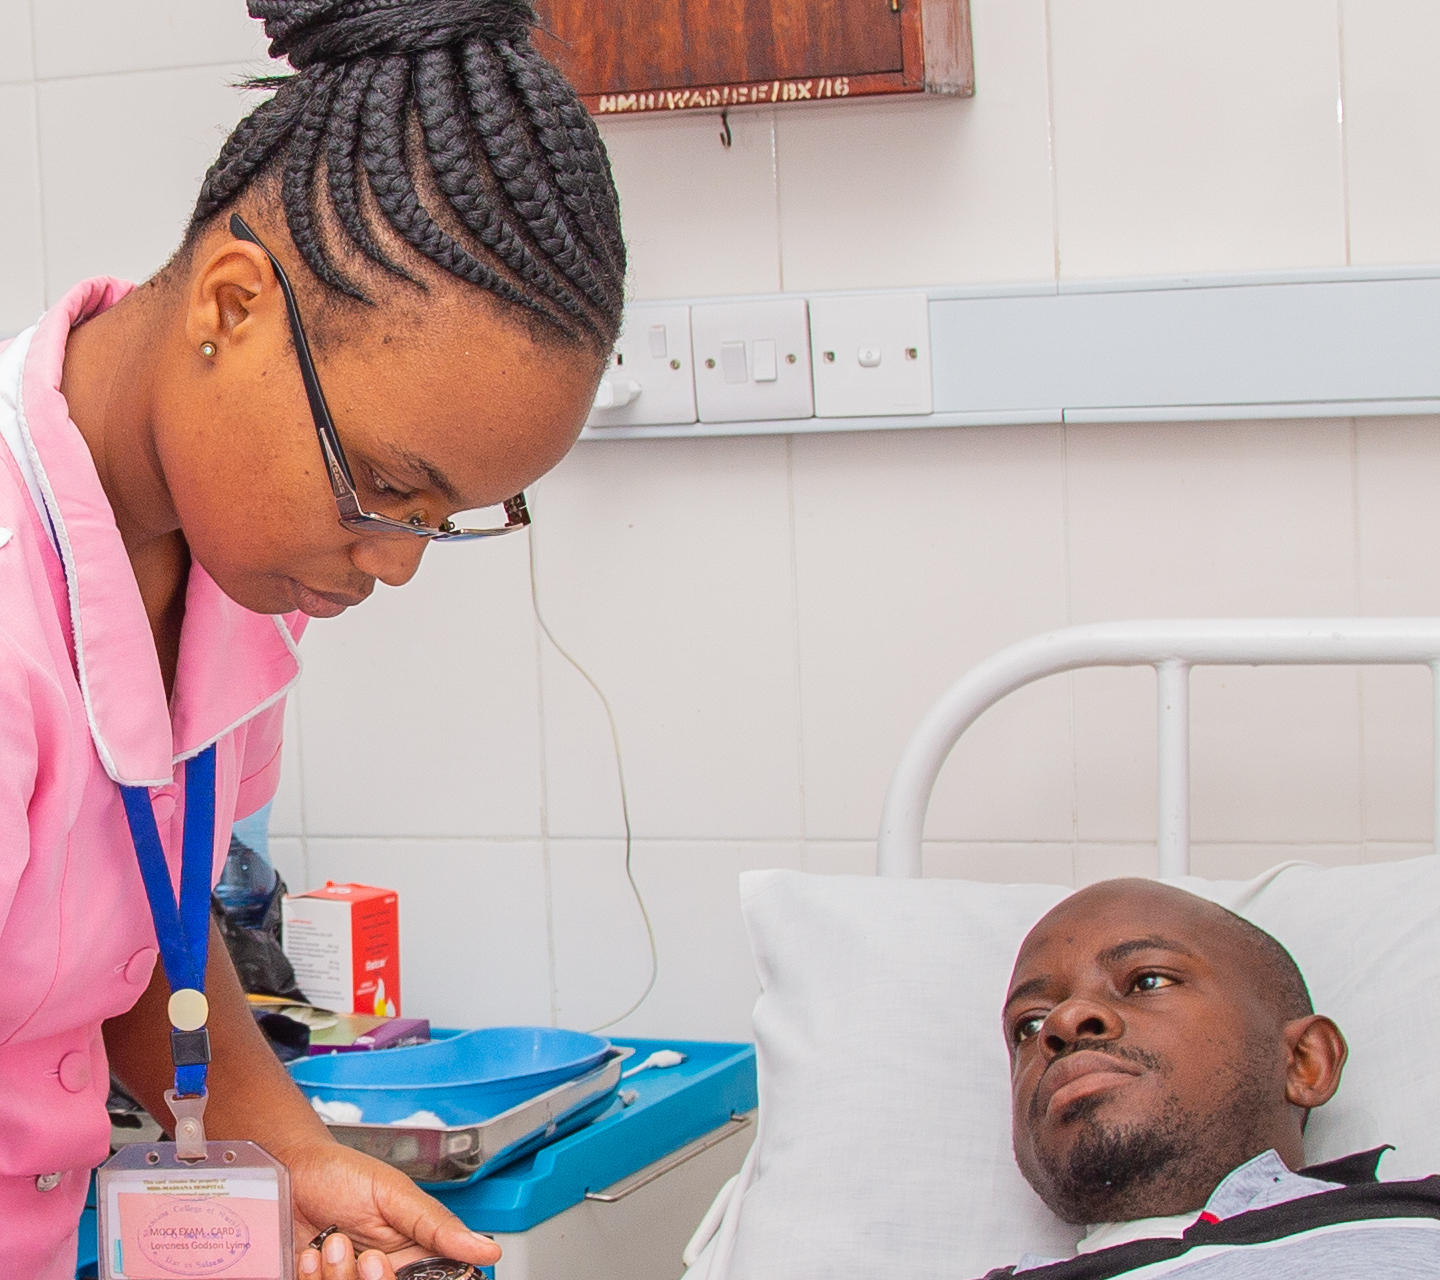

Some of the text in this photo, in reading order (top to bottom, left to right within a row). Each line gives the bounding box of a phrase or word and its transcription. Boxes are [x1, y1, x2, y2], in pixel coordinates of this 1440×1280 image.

[150, 1228, 177, 1236] MOCK
[179, 1228, 203, 1236] EXAM
[211, 1227, 235, 1235] CARD
[150, 1242, 189, 1250] Loveness
[191, 1241, 224, 1250] Godson
